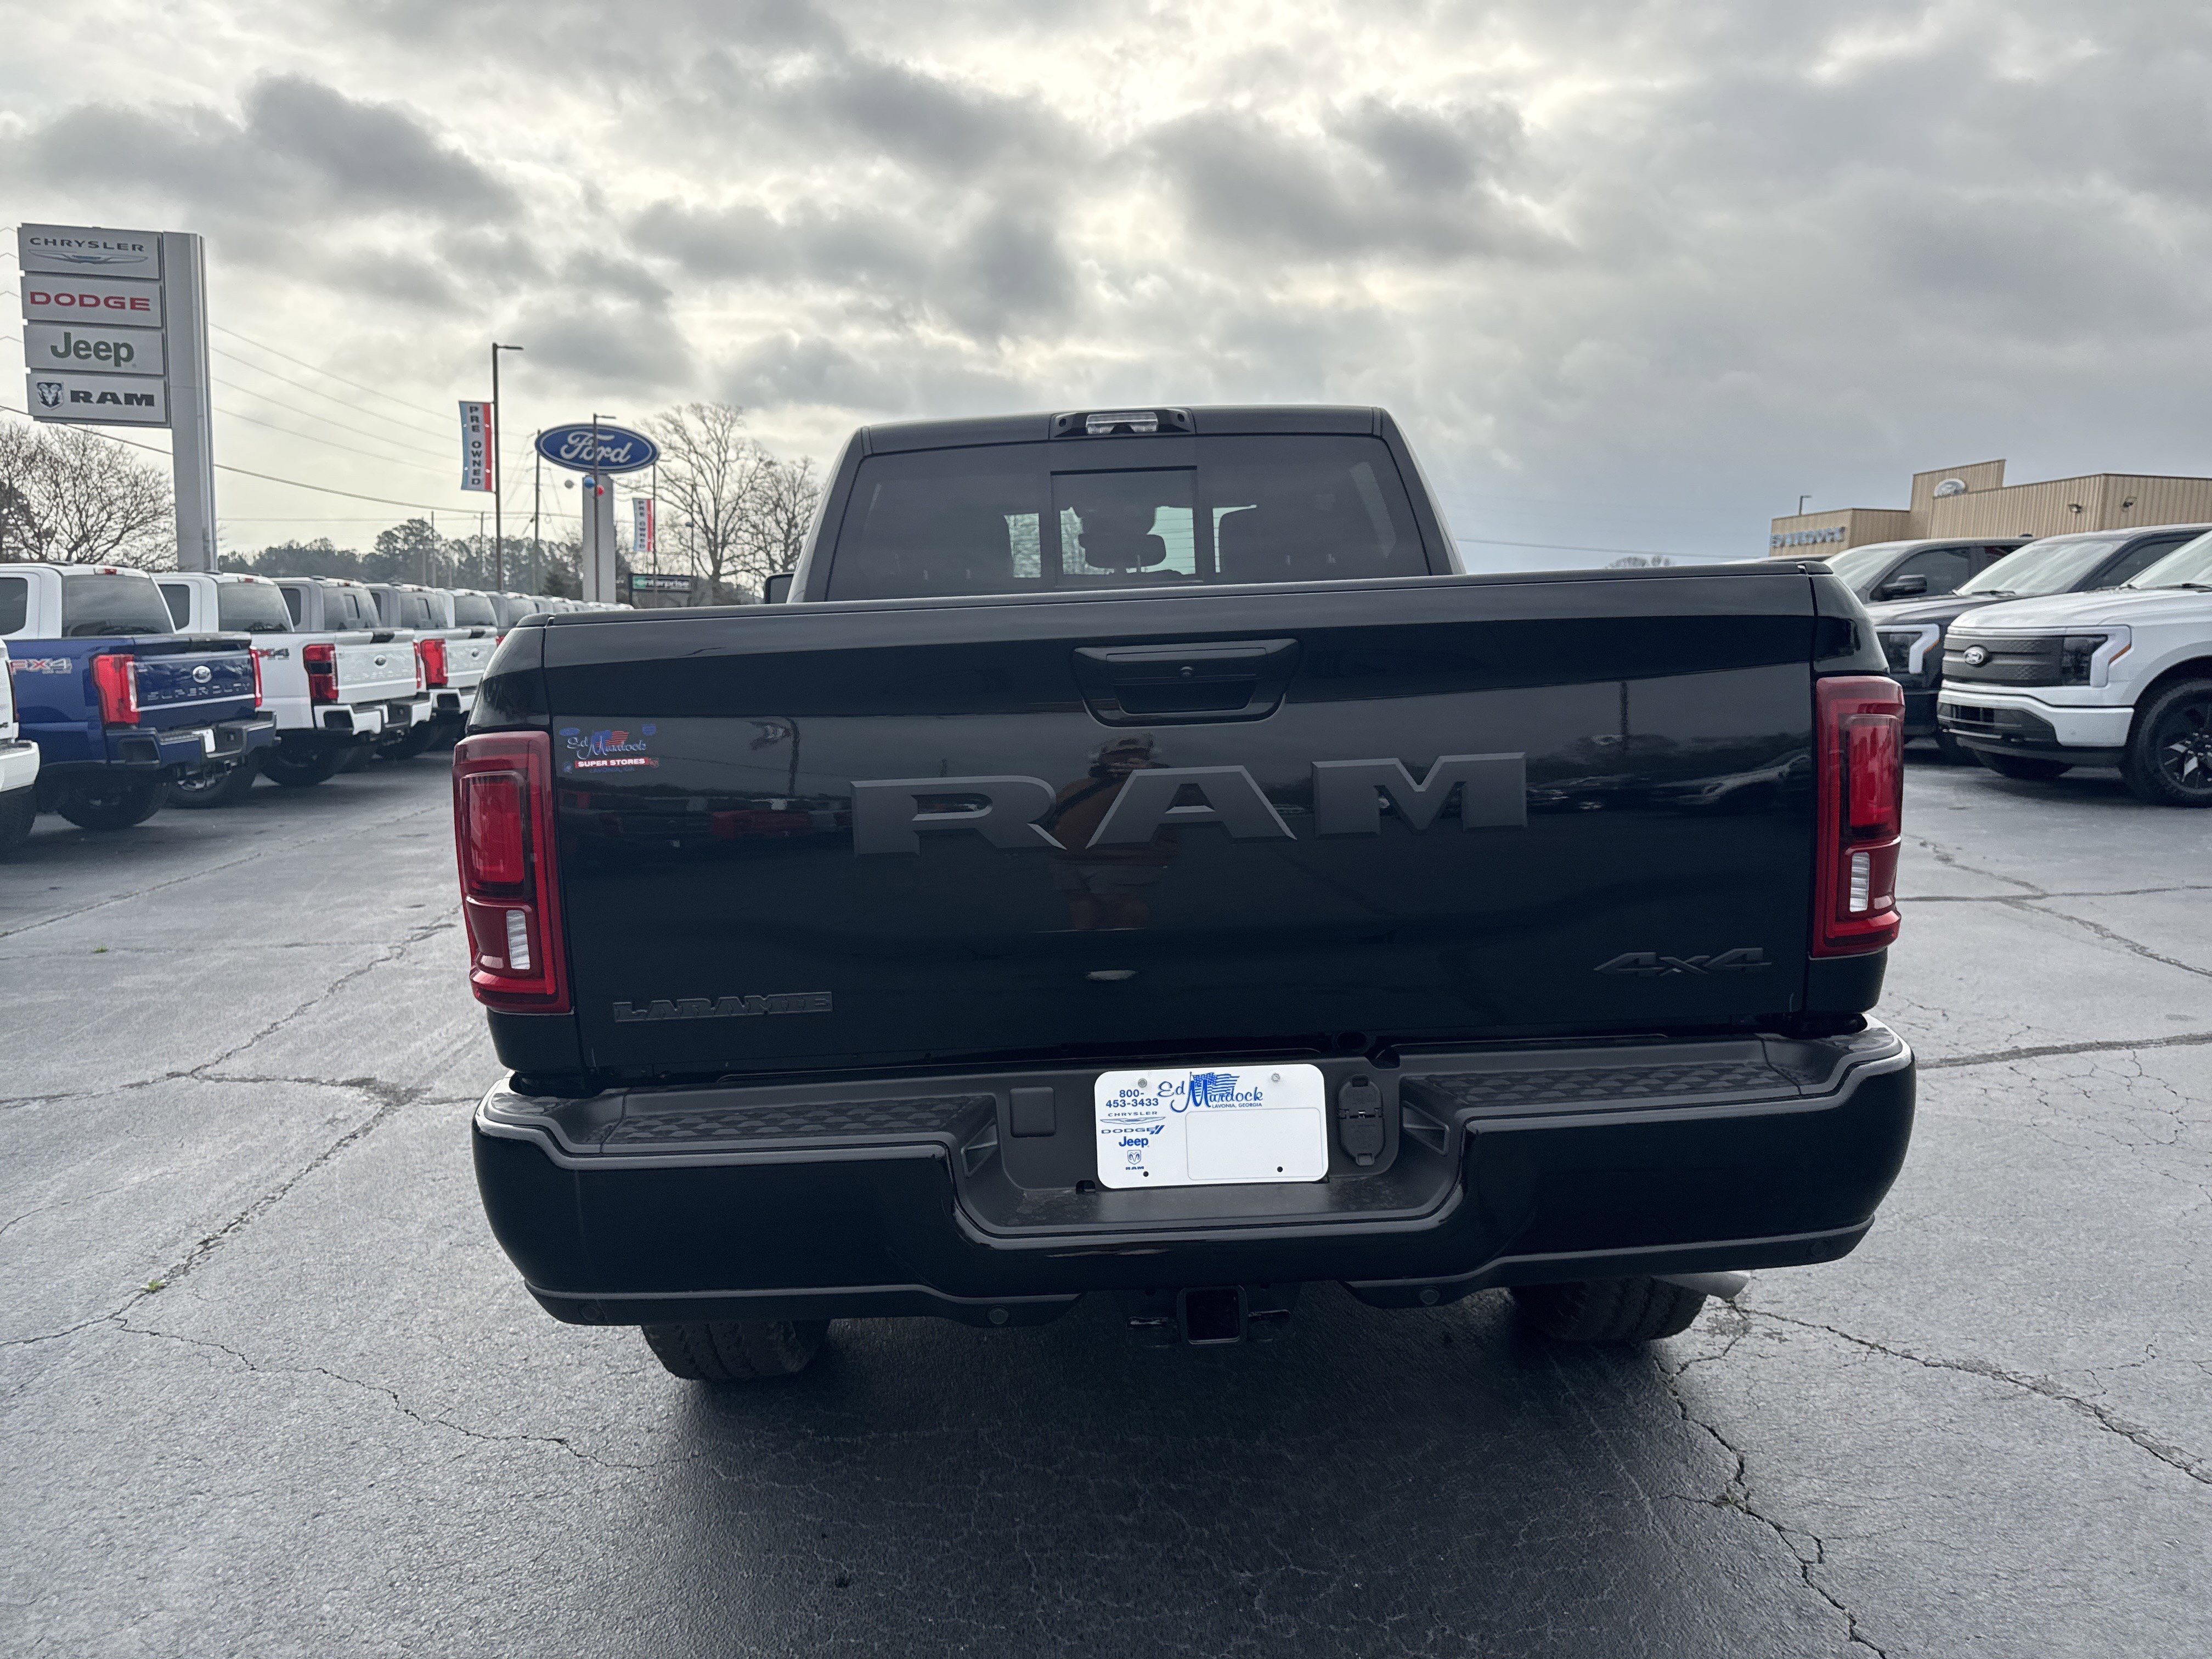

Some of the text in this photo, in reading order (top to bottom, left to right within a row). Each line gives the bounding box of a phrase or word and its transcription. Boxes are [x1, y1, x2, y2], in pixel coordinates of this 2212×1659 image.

[29, 237, 145, 252] CHRYSLER
[29, 291, 151, 312] DODGE
[50, 331, 134, 368] Jeep
[70, 390, 155, 407] RAM
[469, 405, 483, 486] PRE OWNED
[559, 431, 633, 464] Ford
[566, 736, 589, 749] Ed
[578, 759, 608, 768] SUPER
[850, 752, 1528, 857] RAM
[612, 991, 833, 1023] LARAMIE
[1119, 1089, 1144, 1098] 800-
[1156, 1079, 1263, 1113] Ed Murdock
[1105, 1098, 1159, 1108] 453-3433
[1101, 1126, 1155, 1135] DODGE
[1118, 1136, 1149, 1148] Jeep
